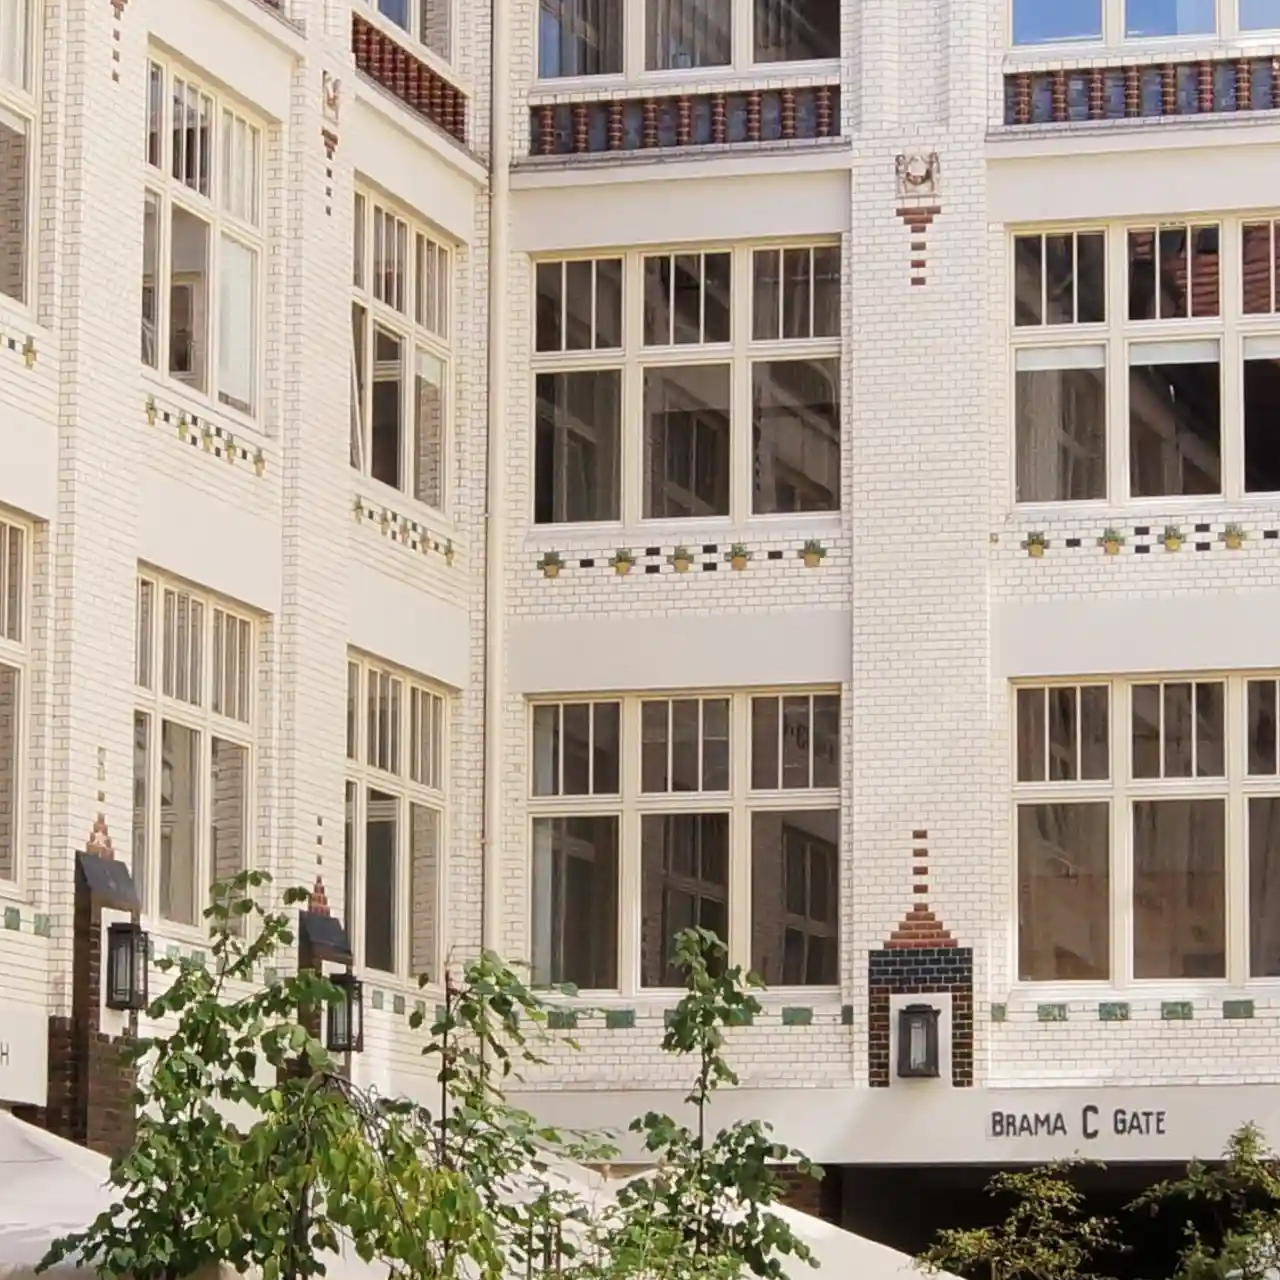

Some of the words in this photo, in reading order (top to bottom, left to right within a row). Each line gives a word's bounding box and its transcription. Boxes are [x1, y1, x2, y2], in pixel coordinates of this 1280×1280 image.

[991, 1111, 1068, 1137] BRAMA
[1081, 1104, 1100, 1139] C
[1113, 1108, 1166, 1135] GATE
